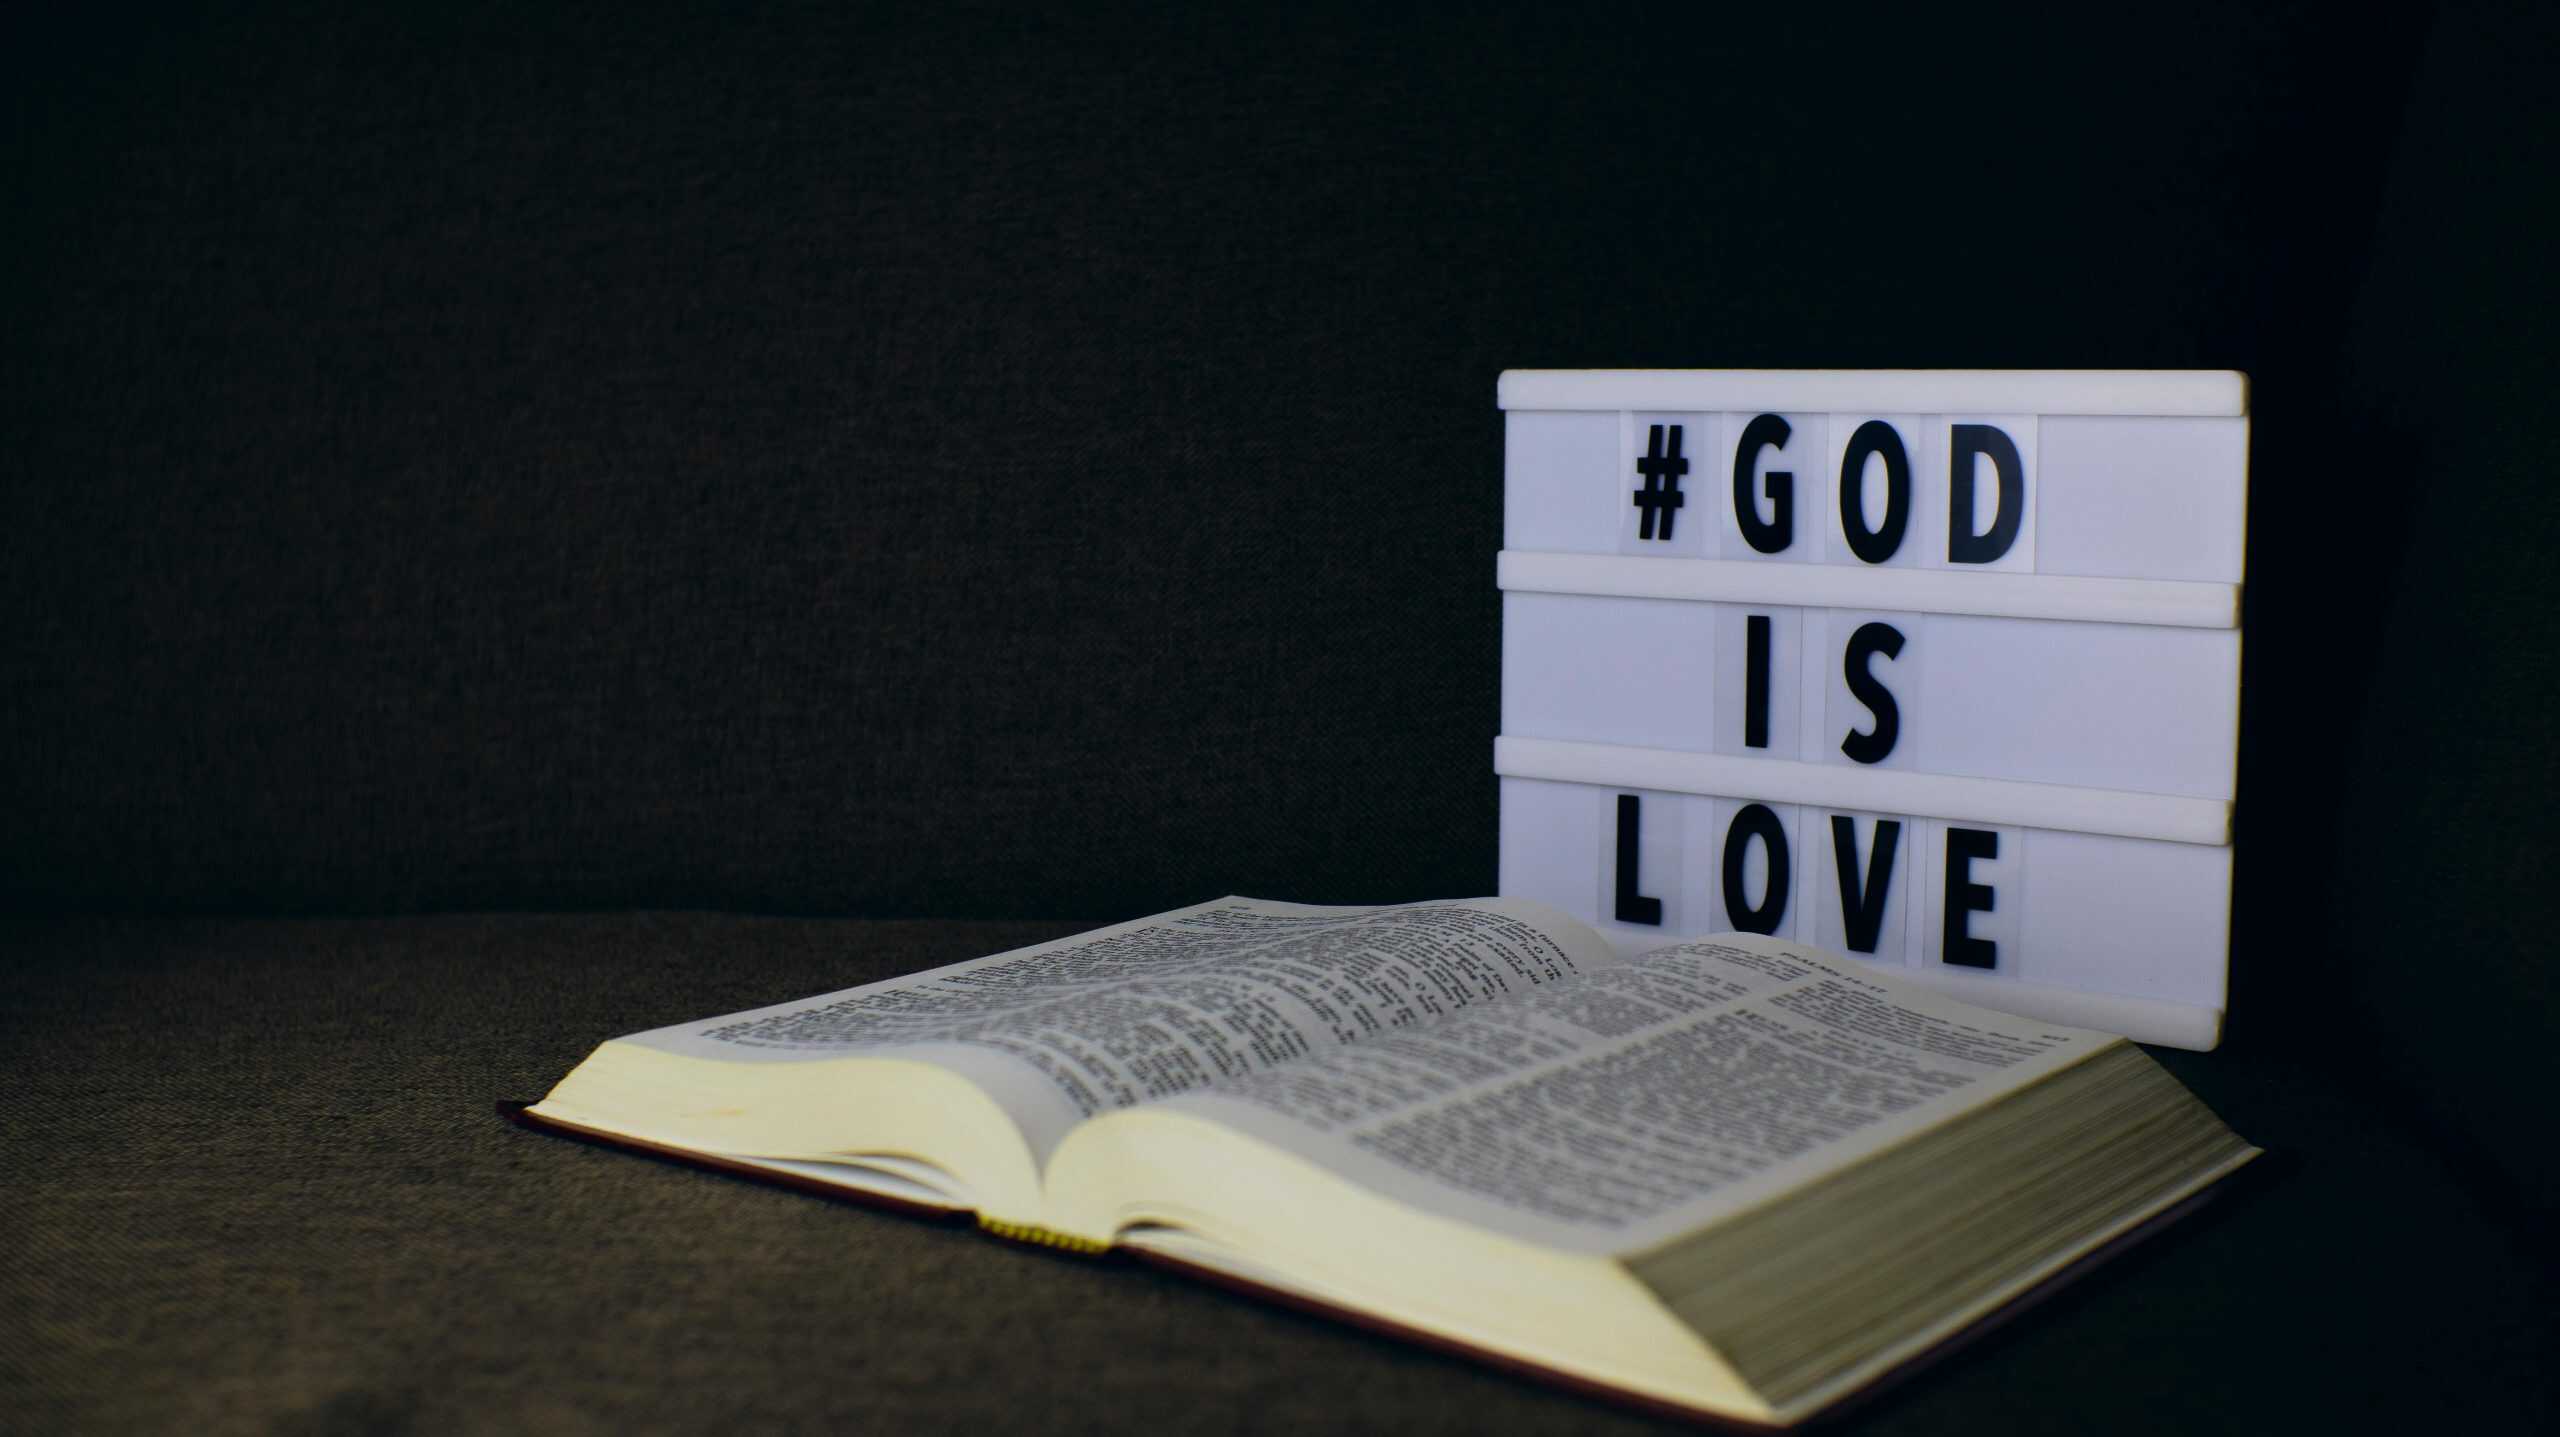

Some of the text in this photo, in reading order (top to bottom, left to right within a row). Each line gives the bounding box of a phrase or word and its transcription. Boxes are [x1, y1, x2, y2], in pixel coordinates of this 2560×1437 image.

[1634, 413, 2025, 565] #GOD
[1745, 615, 1906, 765] IS
[1615, 793, 1999, 970] LOVE
